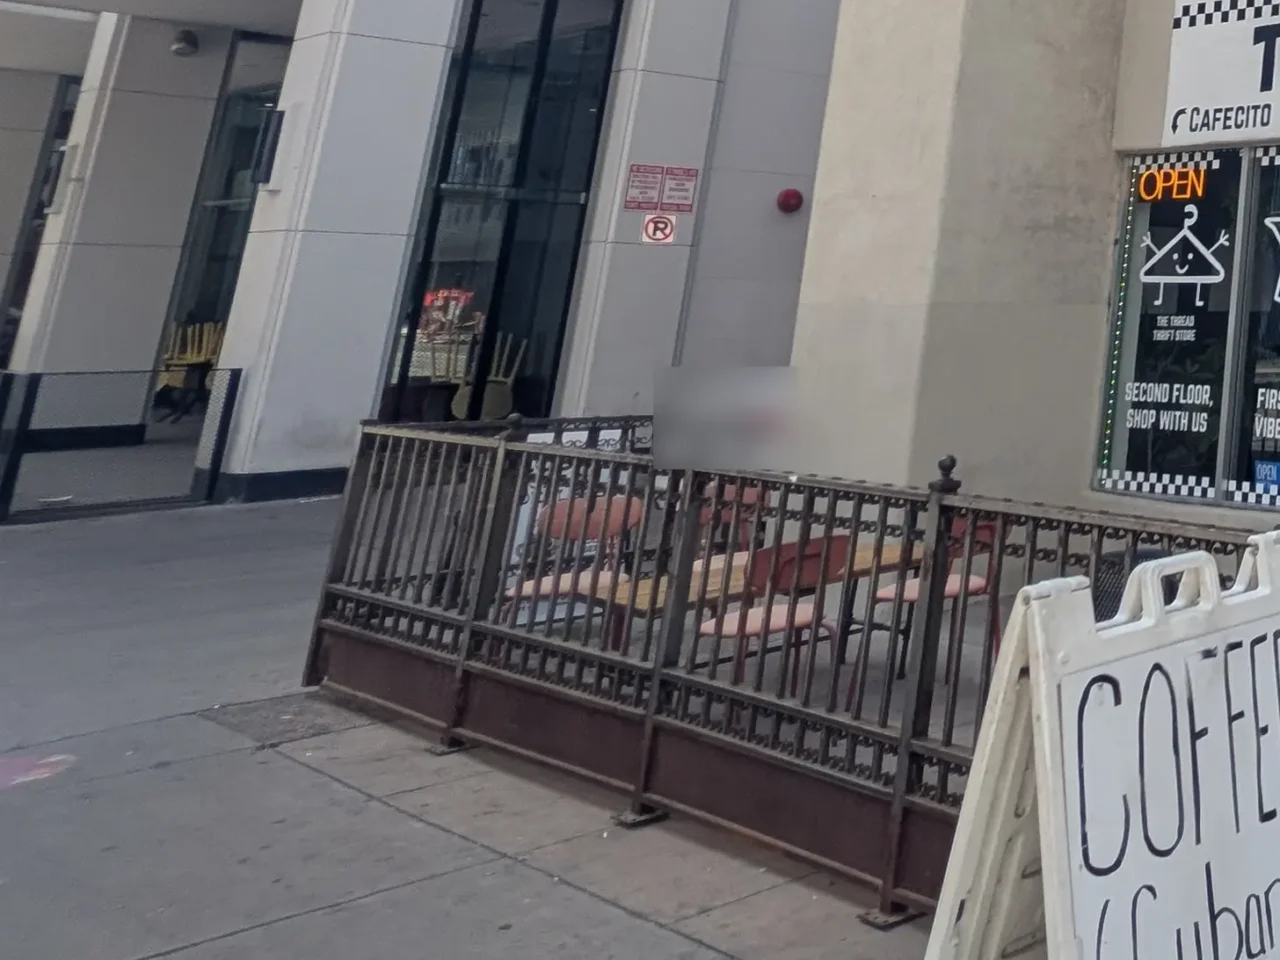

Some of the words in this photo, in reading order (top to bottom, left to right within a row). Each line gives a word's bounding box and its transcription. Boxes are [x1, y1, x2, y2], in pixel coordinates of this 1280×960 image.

[1188, 103, 1272, 133] CAFECITO
[1139, 168, 1206, 201] OPEN
[1124, 381, 1171, 403] SECOND
[1172, 383, 1214, 408] FLOOR,
[1126, 408, 1156, 430] SHOP
[1159, 409, 1189, 431] WITH
[1191, 411, 1208, 433] US
[1256, 463, 1278, 482] OPEN
